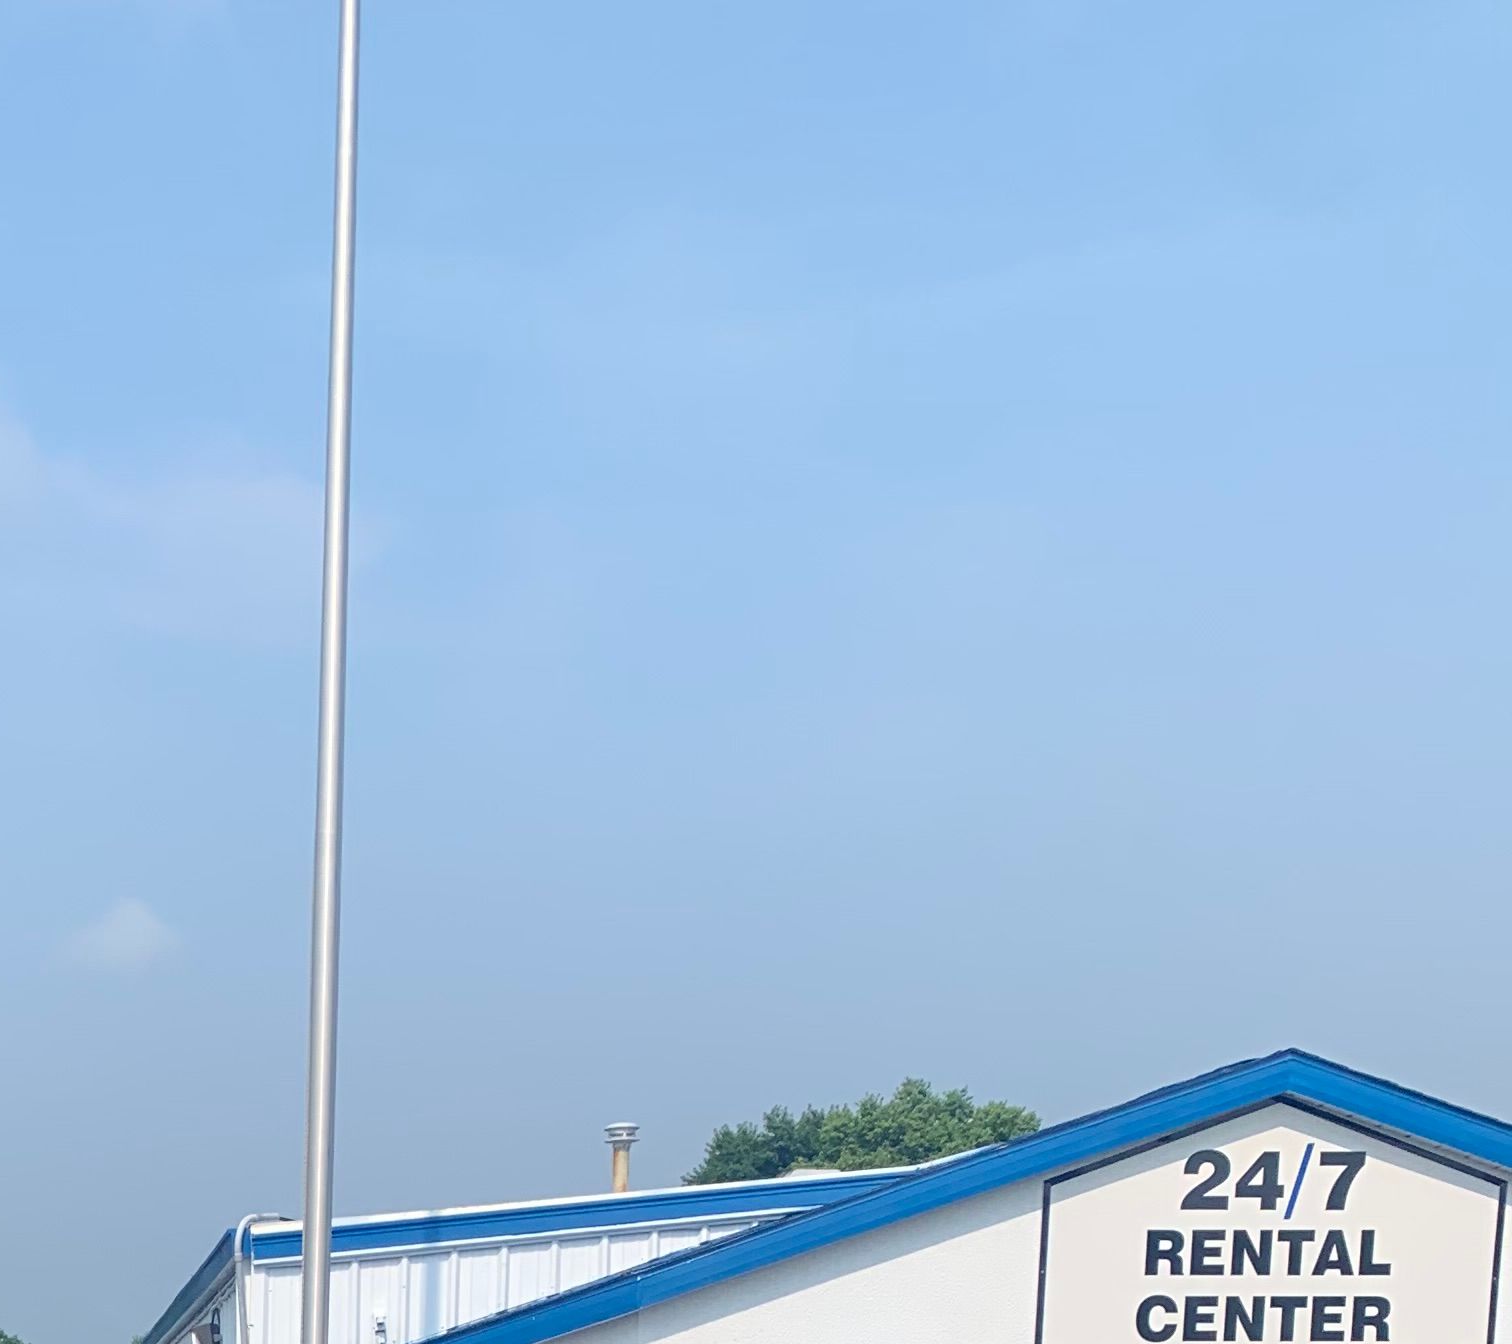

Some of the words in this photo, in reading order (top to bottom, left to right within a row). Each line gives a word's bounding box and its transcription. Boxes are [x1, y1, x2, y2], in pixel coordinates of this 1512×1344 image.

[1180, 1143, 1367, 1220] 24/7
[1144, 1229, 1392, 1276] RENTAL
[1135, 1294, 1391, 1342] CENTER
